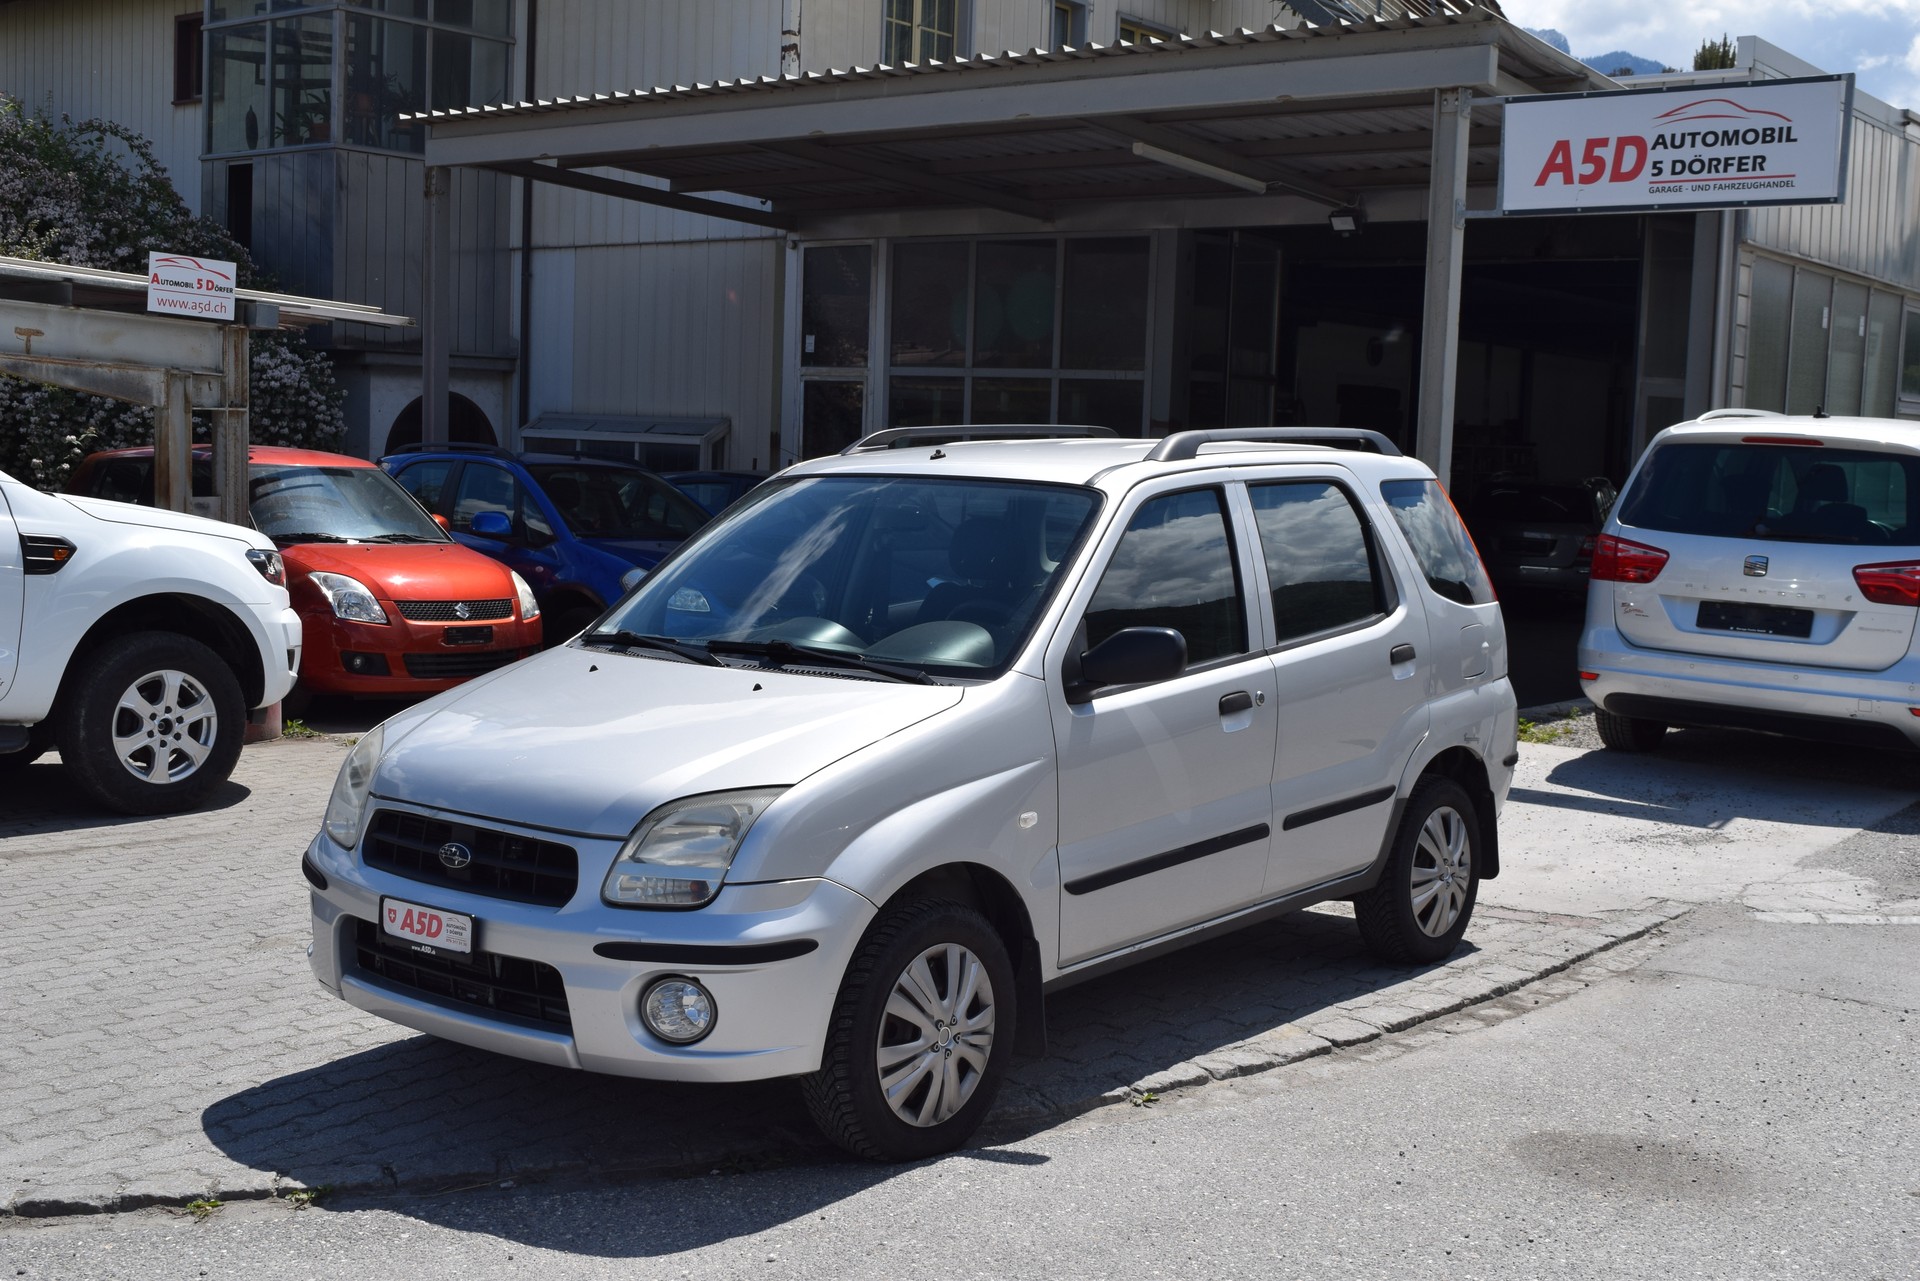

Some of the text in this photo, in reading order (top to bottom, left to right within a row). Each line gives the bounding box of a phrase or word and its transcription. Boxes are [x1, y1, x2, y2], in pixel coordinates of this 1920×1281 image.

[1650, 126, 1798, 150] AUTOMOBIL
[1534, 136, 1648, 187] A5D
[1651, 155, 1767, 177] 5 DÖRFER
[1648, 185, 1683, 194] GARAGE
[1691, 184, 1711, 192] UND
[1713, 180, 1796, 191] FAHRZEUGHANDEL
[196, 278, 203, 290] 5
[157, 297, 227, 314] www.a5d.ch
[400, 908, 443, 939] A5D
